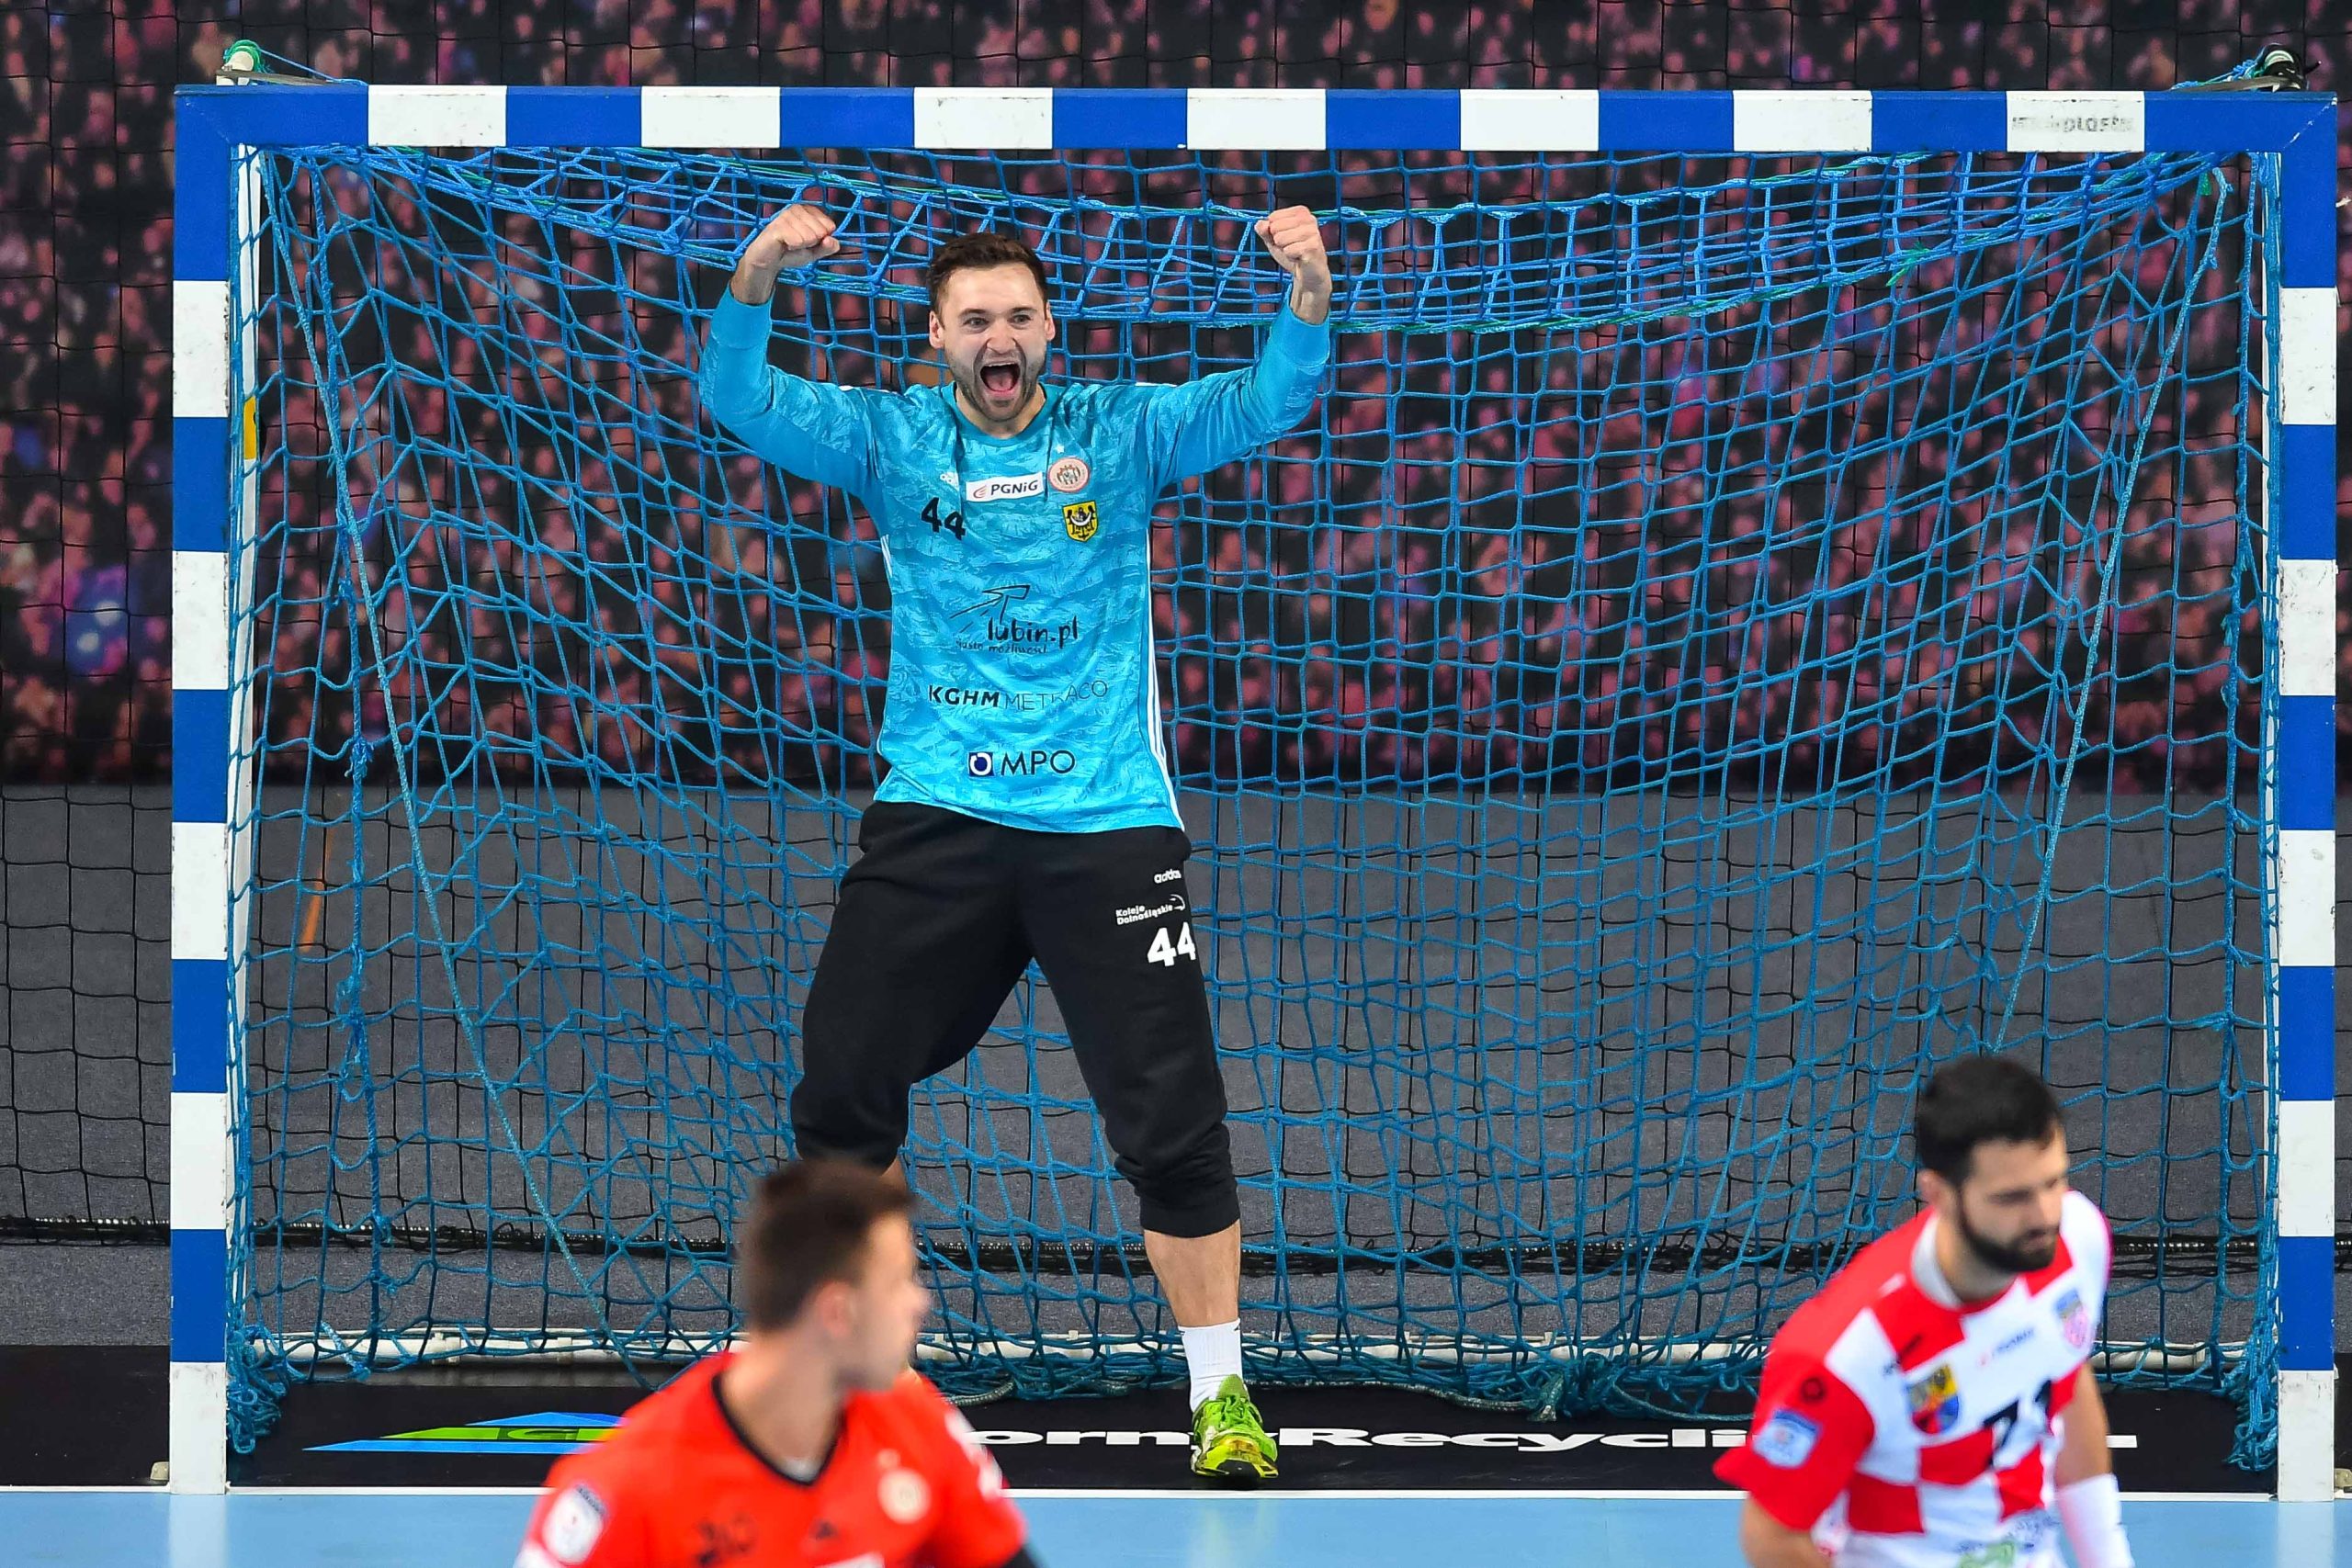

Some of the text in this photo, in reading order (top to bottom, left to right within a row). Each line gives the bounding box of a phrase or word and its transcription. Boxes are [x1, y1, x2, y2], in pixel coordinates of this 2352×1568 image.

[990, 479, 1038, 495] PGNiG
[922, 497, 966, 540] 44
[988, 615, 1078, 649] lubin.pl
[929, 684, 1000, 707] KGHM
[1001, 750, 1076, 774] MPO
[1148, 922, 1196, 967] 44
